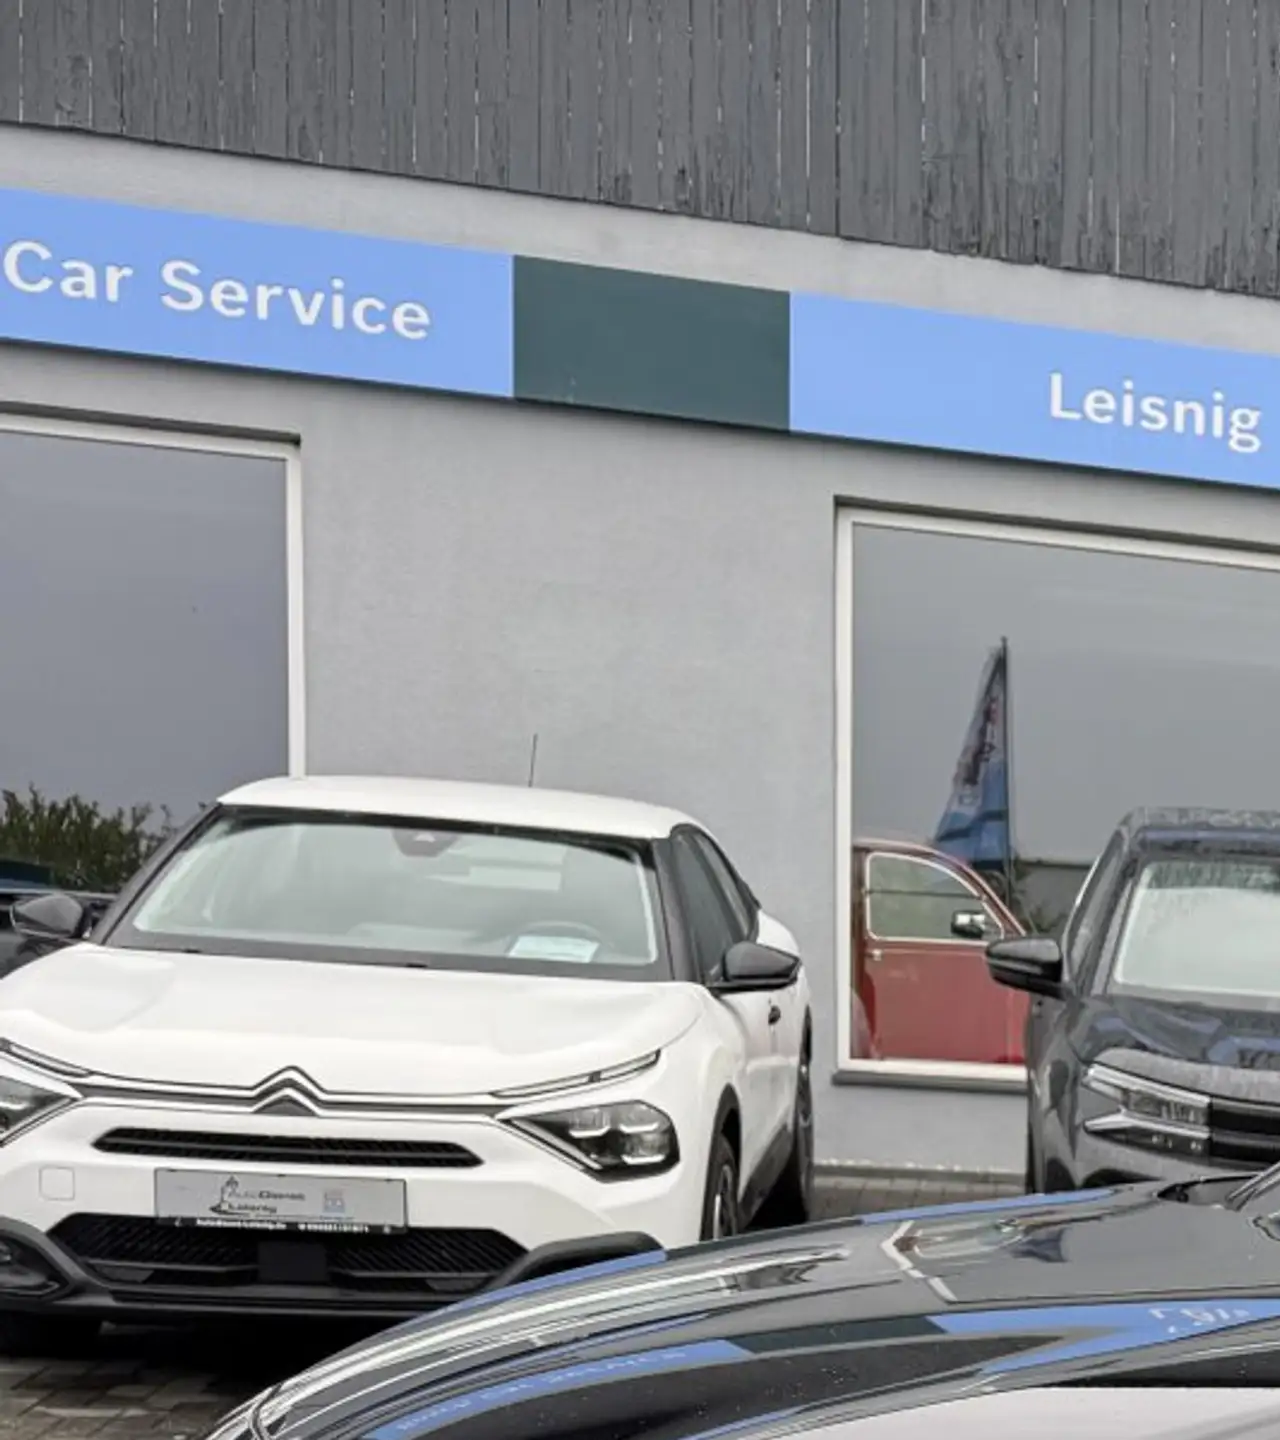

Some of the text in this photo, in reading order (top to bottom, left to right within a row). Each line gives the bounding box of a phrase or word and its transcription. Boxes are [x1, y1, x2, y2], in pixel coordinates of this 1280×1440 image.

[3, 240, 431, 340] Car Service
[1050, 372, 1262, 453] Leisnig
